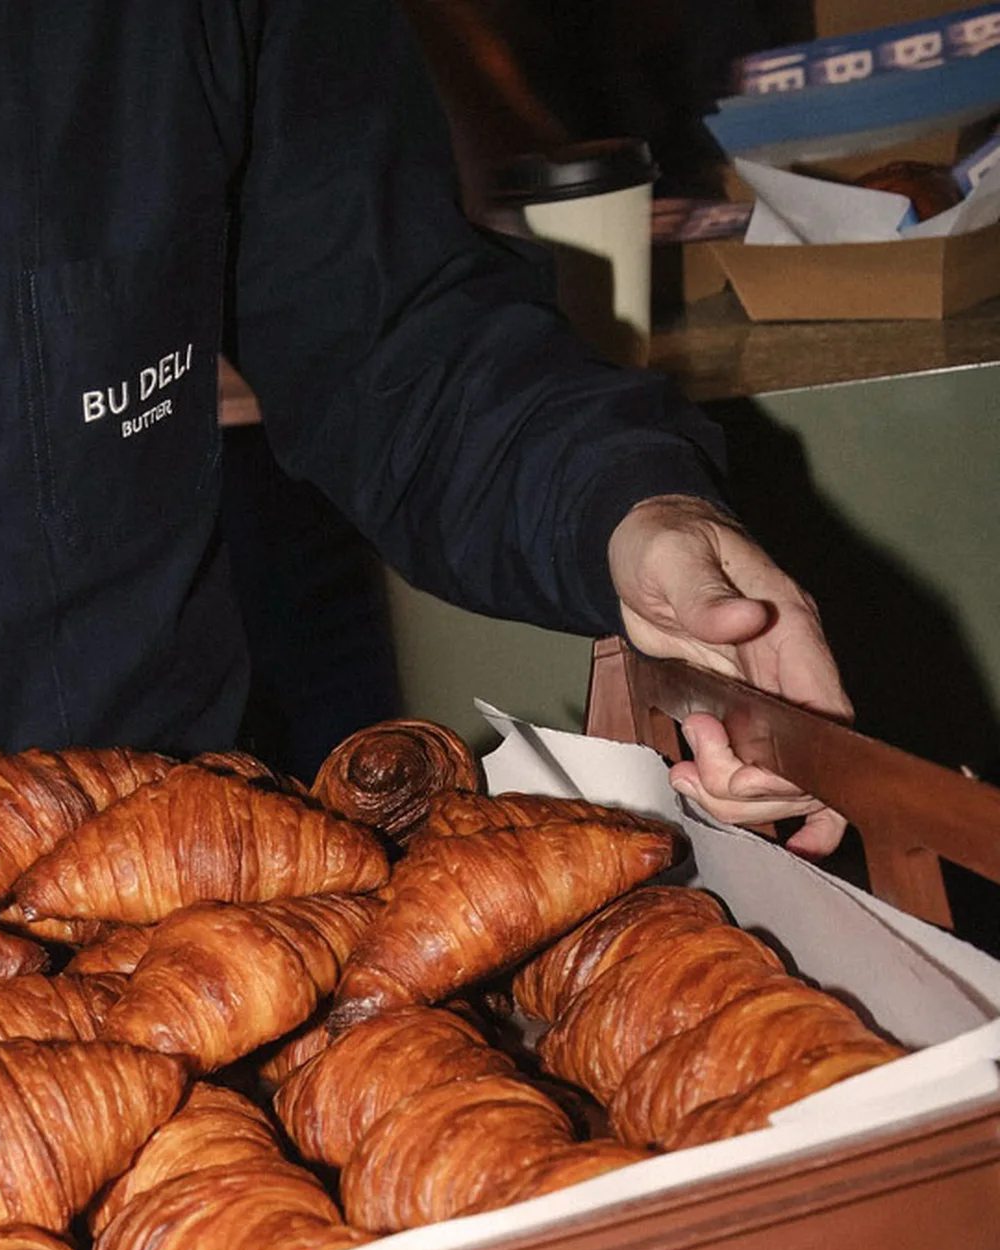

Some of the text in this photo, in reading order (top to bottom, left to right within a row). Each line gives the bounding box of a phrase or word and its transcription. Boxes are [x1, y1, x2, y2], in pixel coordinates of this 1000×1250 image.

[82, 343, 193, 423] BU DELI
[121, 399, 173, 438] BUTTER
